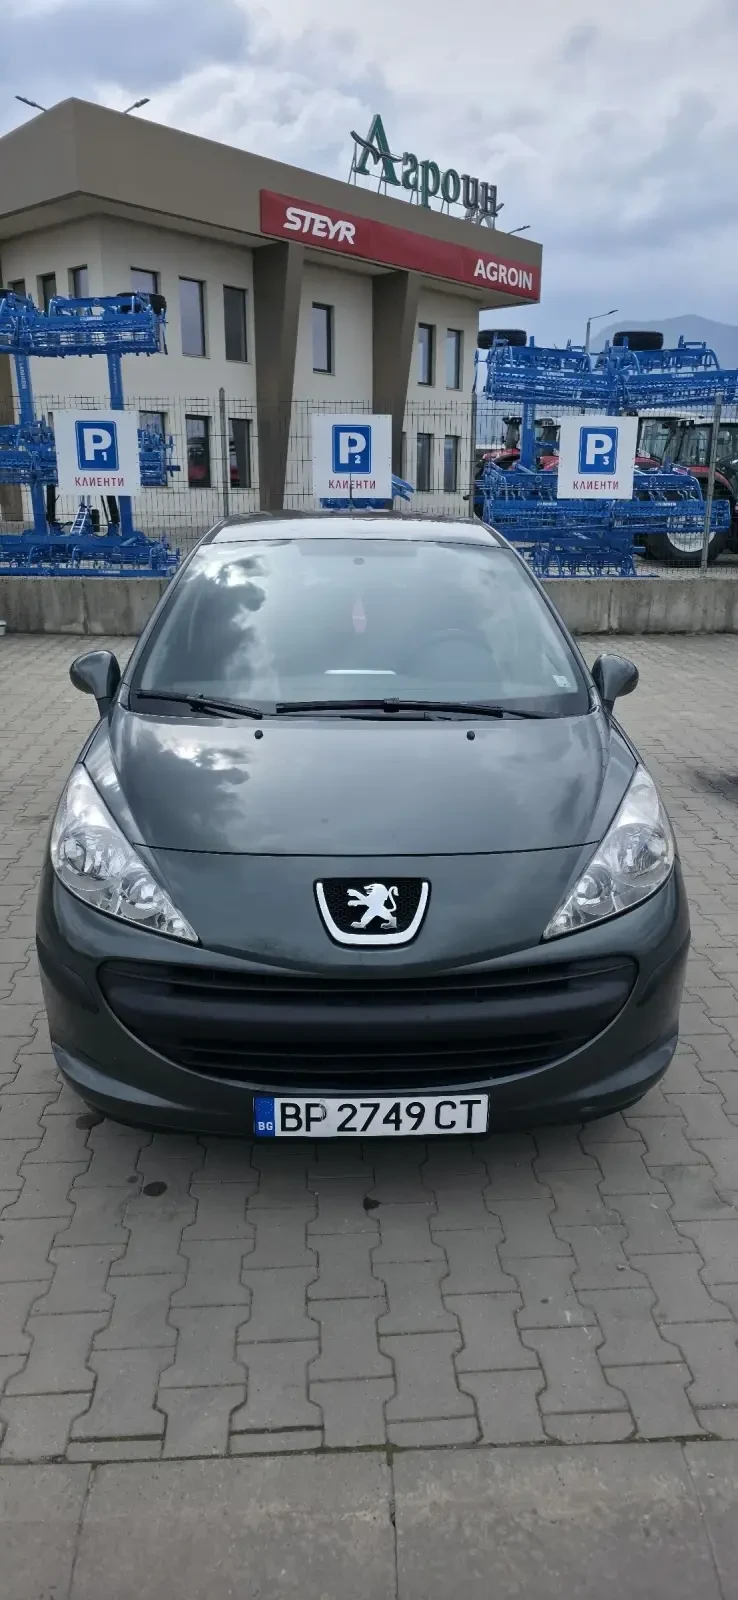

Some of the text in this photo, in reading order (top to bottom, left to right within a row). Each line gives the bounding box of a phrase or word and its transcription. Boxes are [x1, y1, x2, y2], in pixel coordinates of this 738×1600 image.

[283, 207, 355, 244] STEYR
[474, 259, 532, 290] AGROIN
[75, 477, 125, 487] КЛИЕНТИ
[328, 480, 376, 490] КЛИЕНТИ
[573, 480, 619, 490] КЛИЕНТИ
[280, 1099, 482, 1132] BP 2749 CT
[258, 1121, 273, 1131] BG
